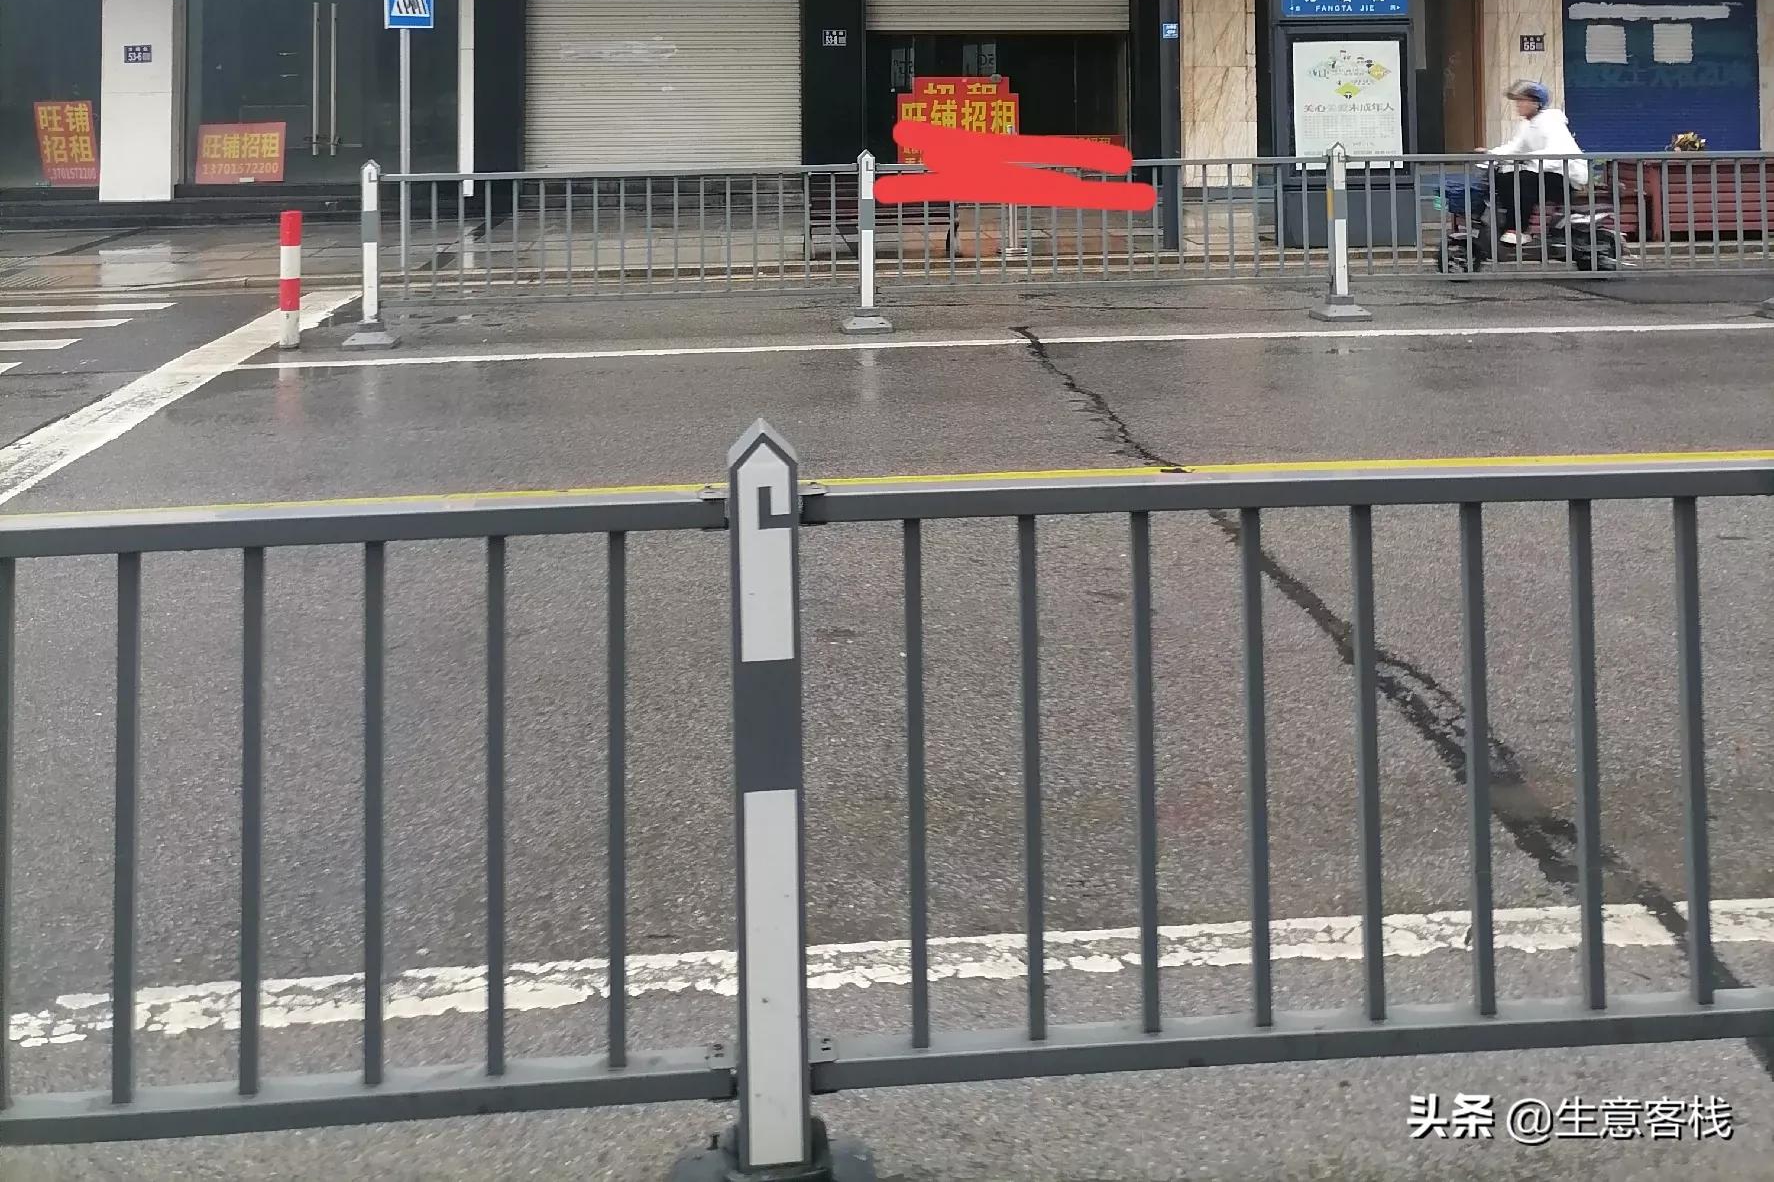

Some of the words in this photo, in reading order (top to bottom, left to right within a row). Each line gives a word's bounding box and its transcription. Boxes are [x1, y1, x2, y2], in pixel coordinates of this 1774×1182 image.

[1315, 4, 1353, 12] FANGTA
[1359, 4, 1375, 12] JIE
[38, 103, 90, 132] 旺铺
[901, 99, 1015, 135] 旺铺招租
[1303, 102, 1395, 113] 关心未成年人
[42, 135, 95, 164] 招租
[202, 132, 280, 159] 旺铺招租
[202, 162, 279, 175] 13701572200
